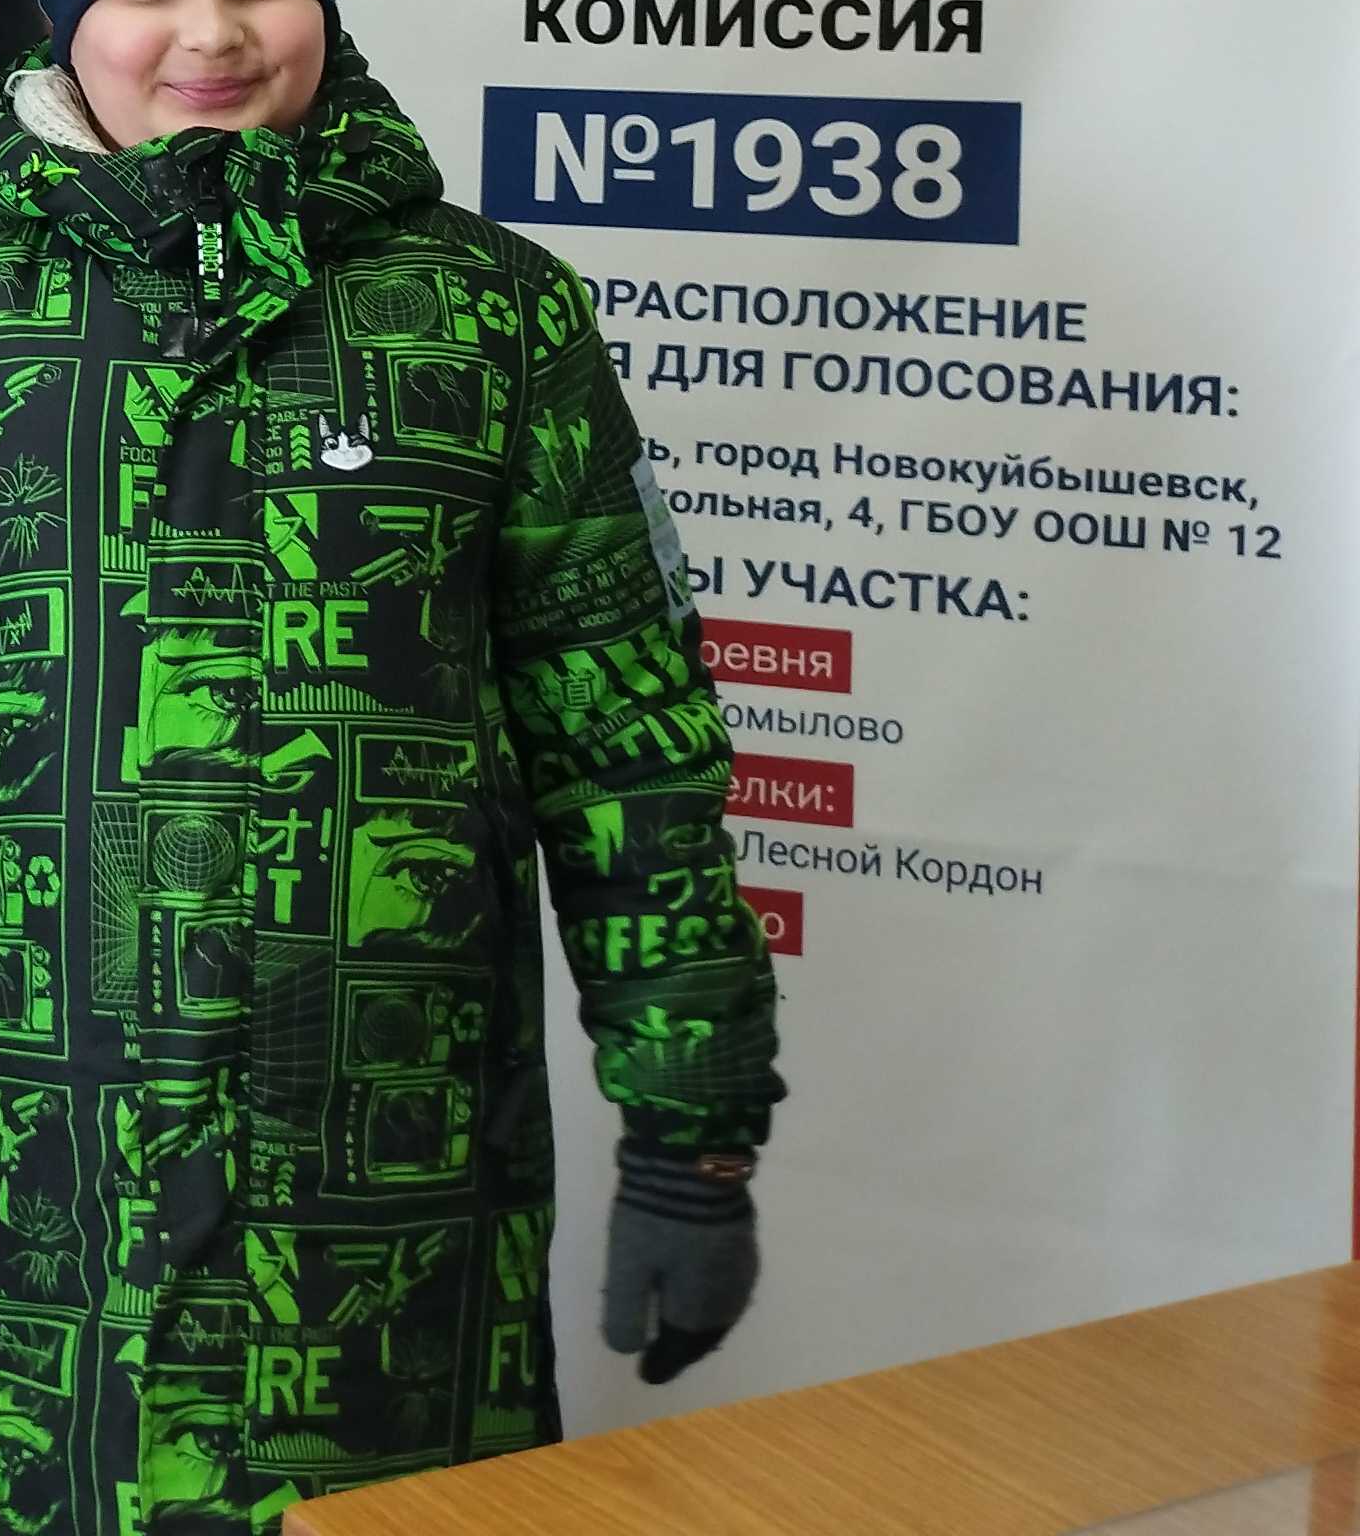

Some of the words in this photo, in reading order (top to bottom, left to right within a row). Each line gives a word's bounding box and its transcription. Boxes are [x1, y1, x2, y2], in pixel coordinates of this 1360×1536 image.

[535, 112, 962, 219] №1938
[202, 222, 219, 273] CHOICE
[204, 279, 221, 300] MY
[648, 344, 763, 392] ДЛЯ
[784, 352, 1238, 417] ГОЛОСОВАНИЯ:
[696, 441, 819, 478] город
[834, 443, 1257, 510] Новокуйбышевск,
[666, 487, 835, 531] ольная,
[848, 497, 883, 535] 4,
[901, 499, 1018, 538] ГБОУ
[1034, 511, 1145, 548] ООШ
[1163, 519, 1209, 551] №
[1229, 524, 1281, 559] 12
[743, 559, 1028, 621] УЧАСТКА:
[716, 696, 904, 745] омылово
[736, 830, 881, 876] Лесной
[897, 847, 1041, 895] Кордон
